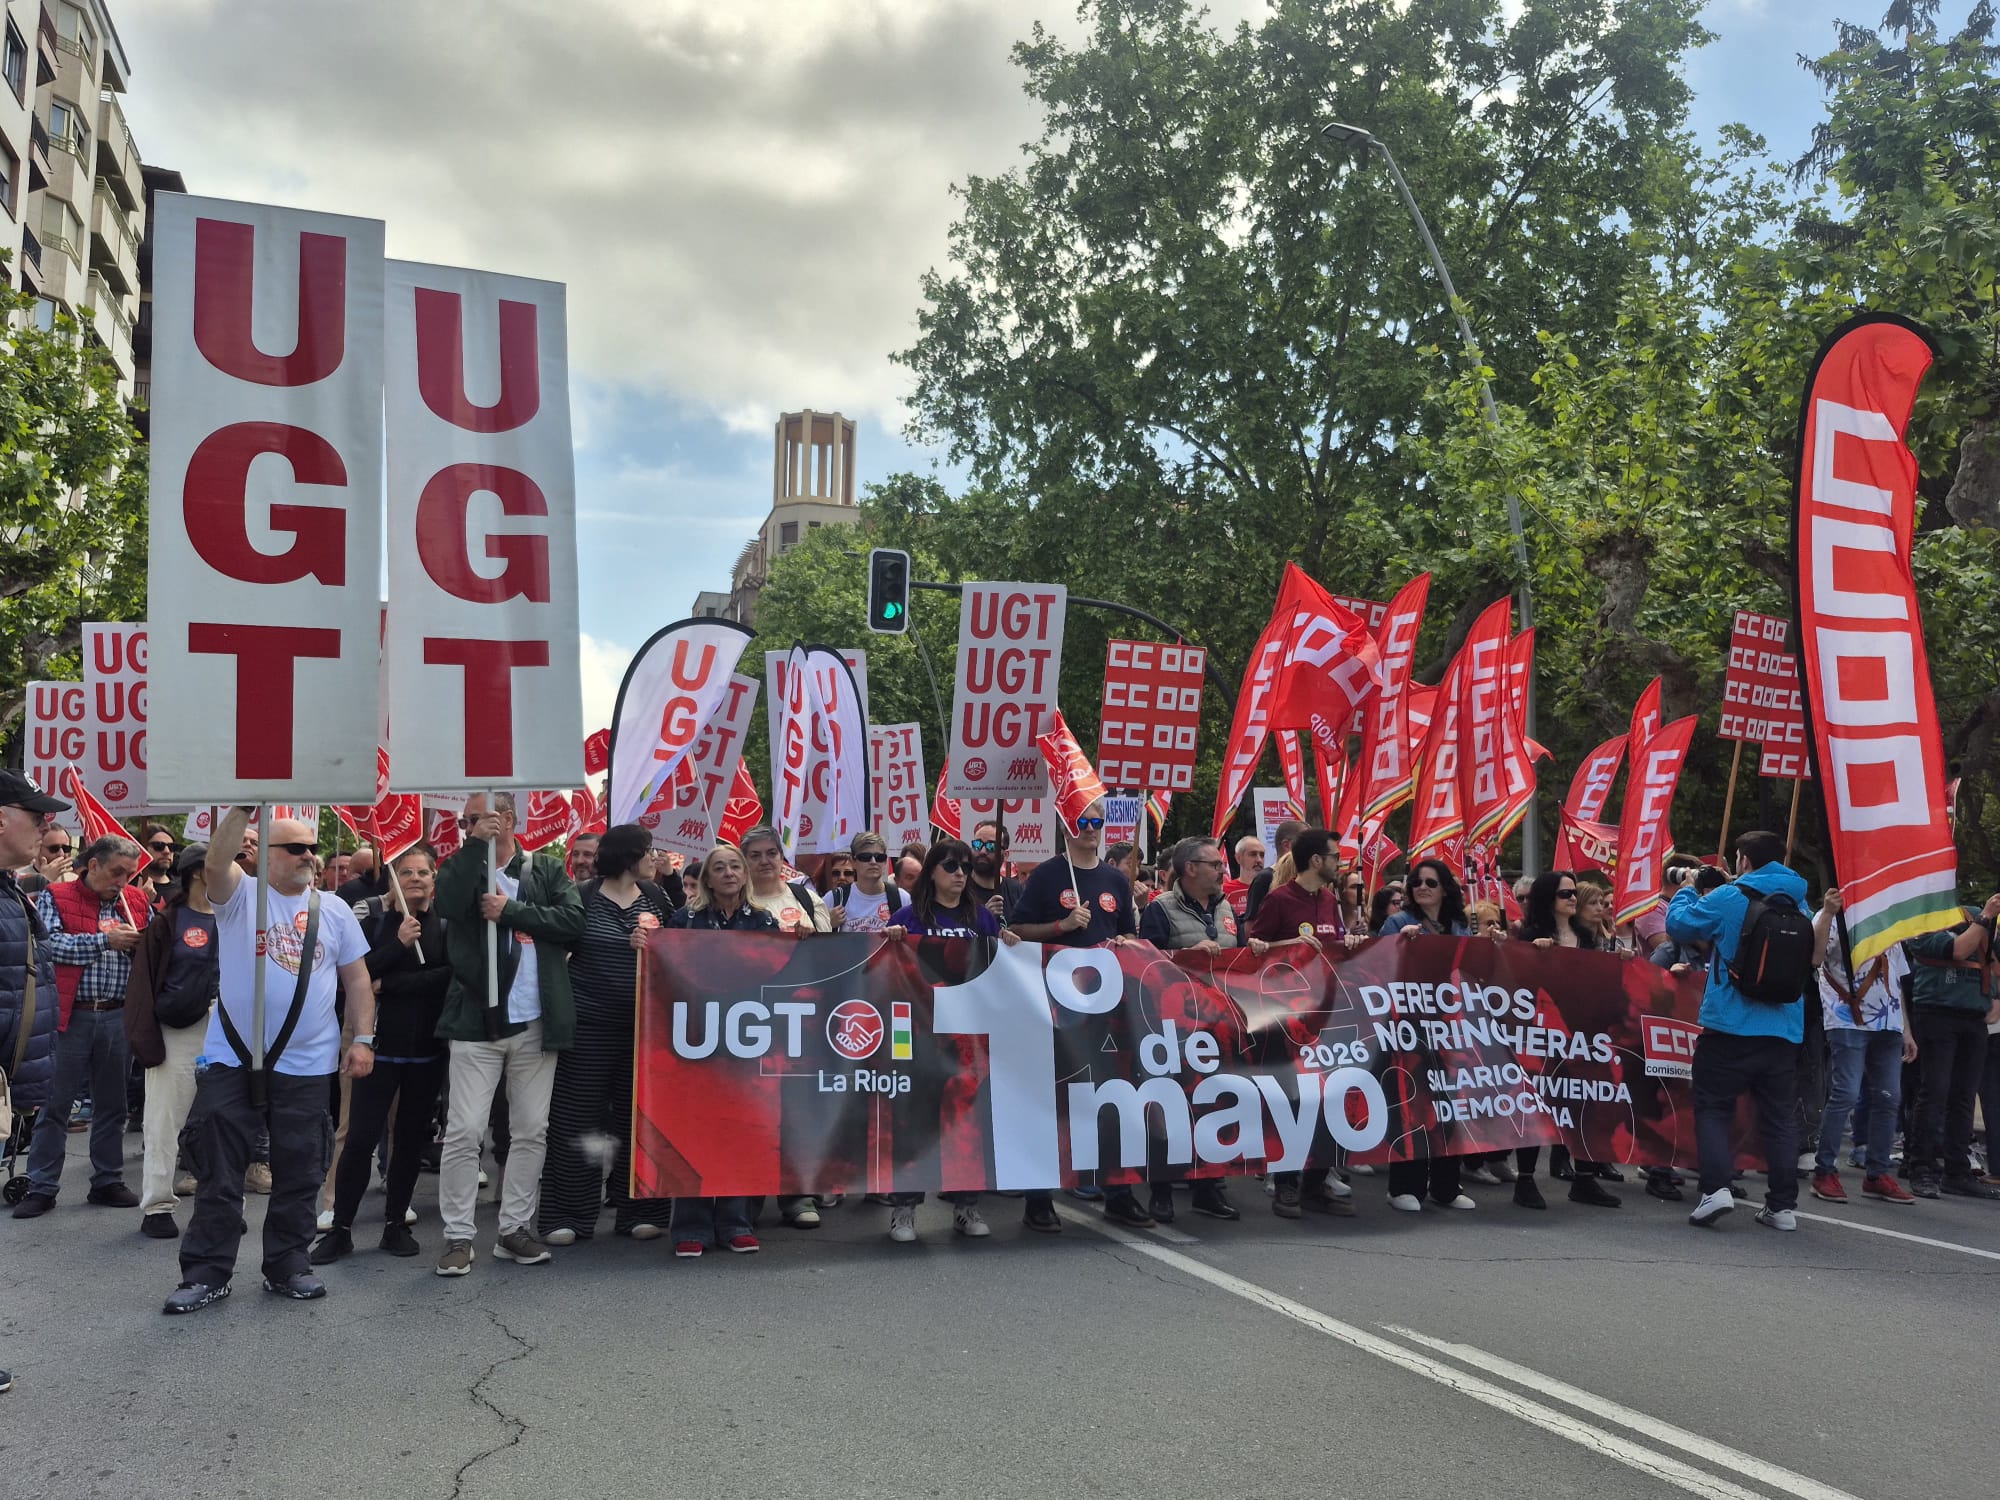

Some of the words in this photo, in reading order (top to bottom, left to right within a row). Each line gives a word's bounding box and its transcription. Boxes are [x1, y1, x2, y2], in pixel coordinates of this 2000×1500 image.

[183, 217, 347, 779] UGT
[415, 286, 550, 777] UGT
[970, 591, 1056, 640] UGT
[1811, 398, 1930, 831] CCOO
[94, 632, 147, 674] UG
[966, 648, 1051, 695] UGT
[35, 688, 86, 721] UG
[96, 681, 147, 723] UG
[34, 727, 86, 760] UG
[692, 723, 737, 767] GT
[884, 728, 914, 760] GT
[962, 702, 1046, 748] UGT
[98, 730, 147, 772] UG
[33, 766, 84, 798] UG
[676, 772, 725, 813] GT
[888, 760, 917, 792] GT
[888, 793, 920, 824] GT
[1358, 981, 1544, 1027] DERECHOS,
[672, 1001, 816, 1060] UGT
[1140, 1019, 1220, 1075] de
[1373, 1019, 1418, 1052] NO
[1300, 1040, 1370, 1069] 2026
[818, 1069, 847, 1092] La
[854, 1069, 911, 1099] Rioja
[1067, 1067, 1389, 1174] mayo
